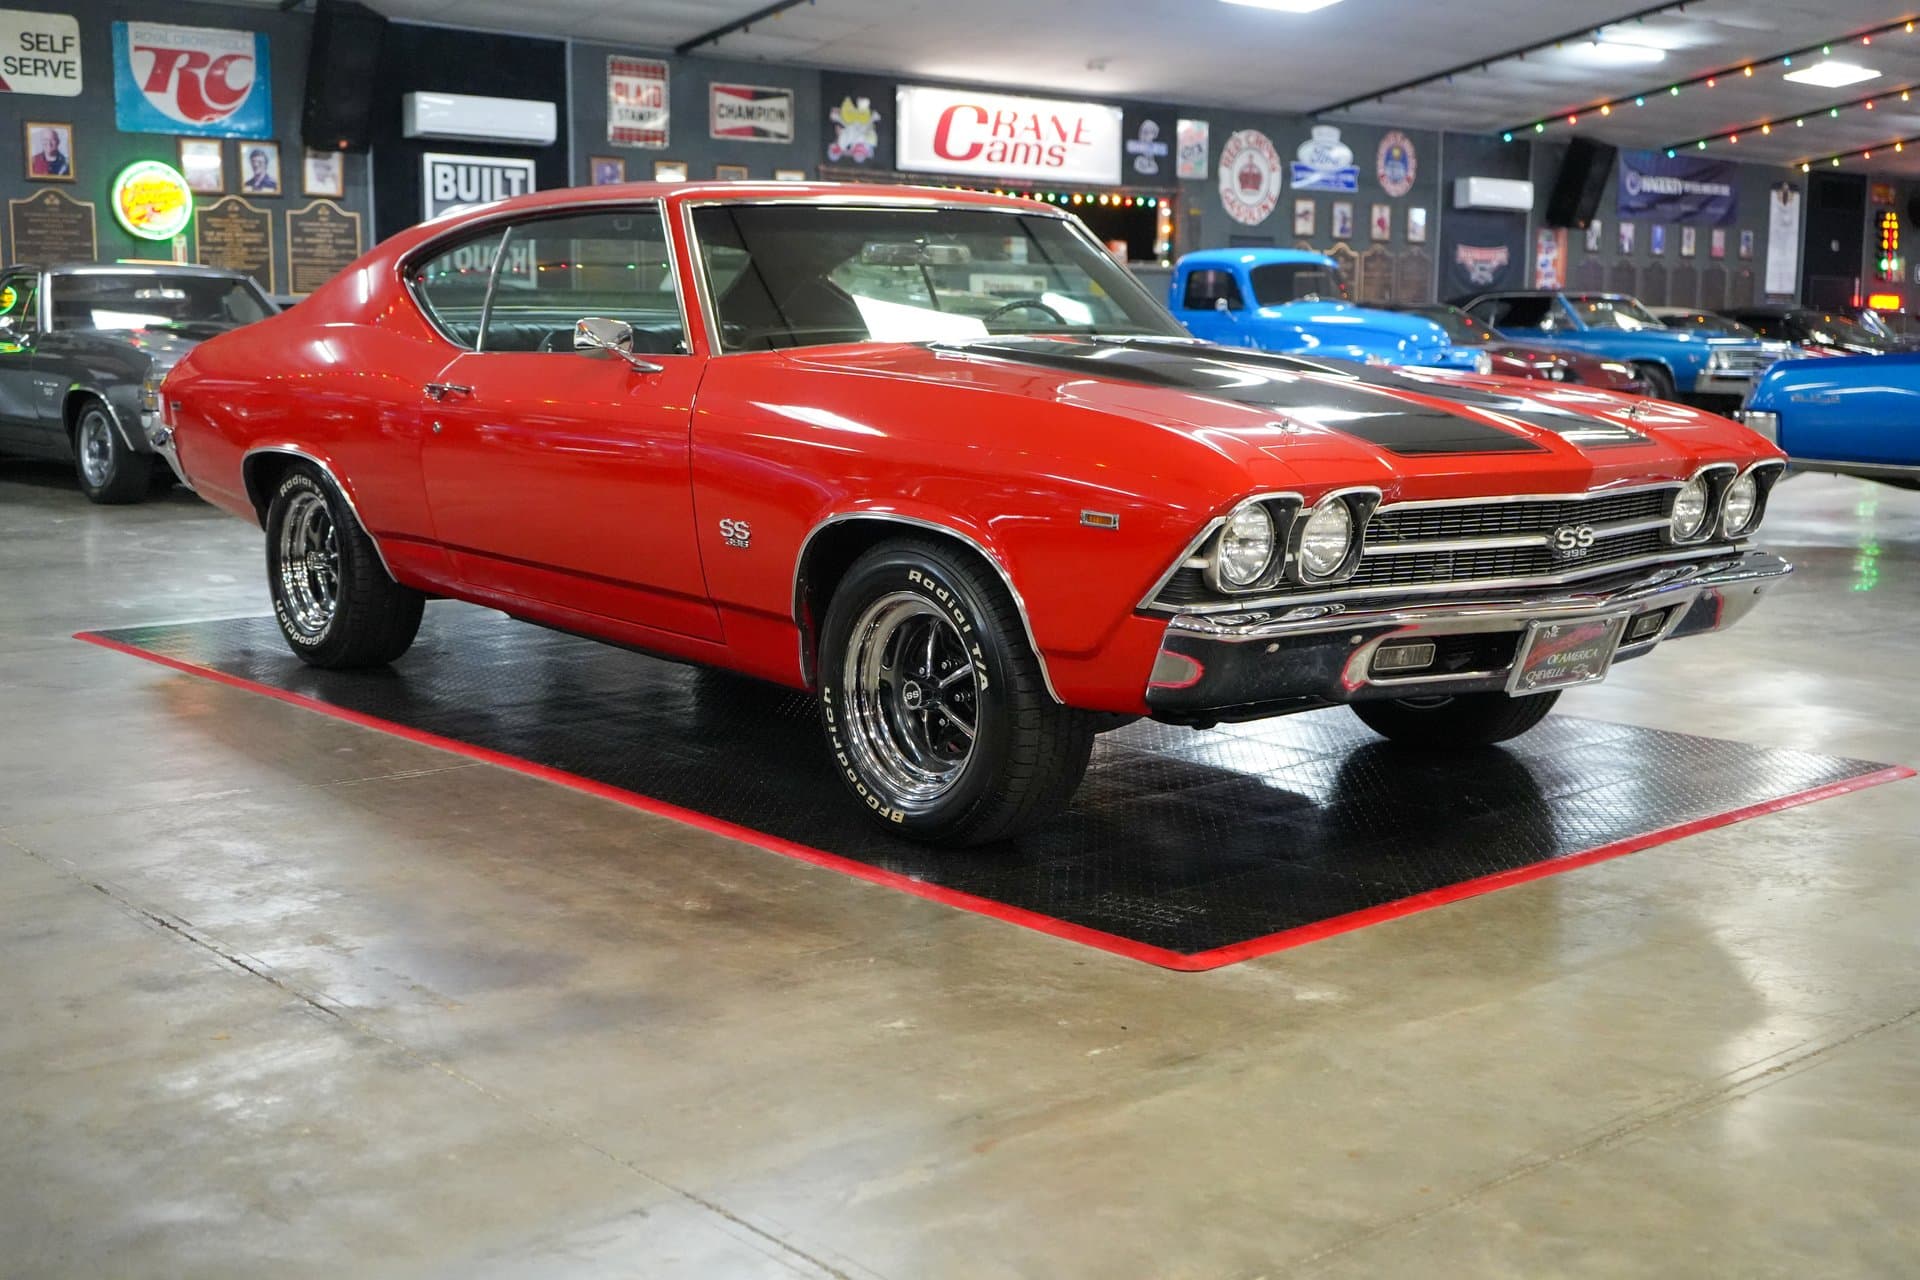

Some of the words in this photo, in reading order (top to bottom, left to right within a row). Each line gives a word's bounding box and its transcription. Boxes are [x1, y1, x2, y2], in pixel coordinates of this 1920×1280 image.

[20, 32, 75, 54] SELF
[3, 55, 77, 80] SERVE
[133, 46, 254, 123] RC
[717, 103, 787, 121] CHAMPION
[434, 163, 526, 202] BUILT
[719, 518, 750, 540] SS
[1556, 527, 1594, 549] SS
[908, 569, 972, 633] Radial
[971, 641, 989, 692] T/A
[823, 686, 905, 824] BFGoodrich
